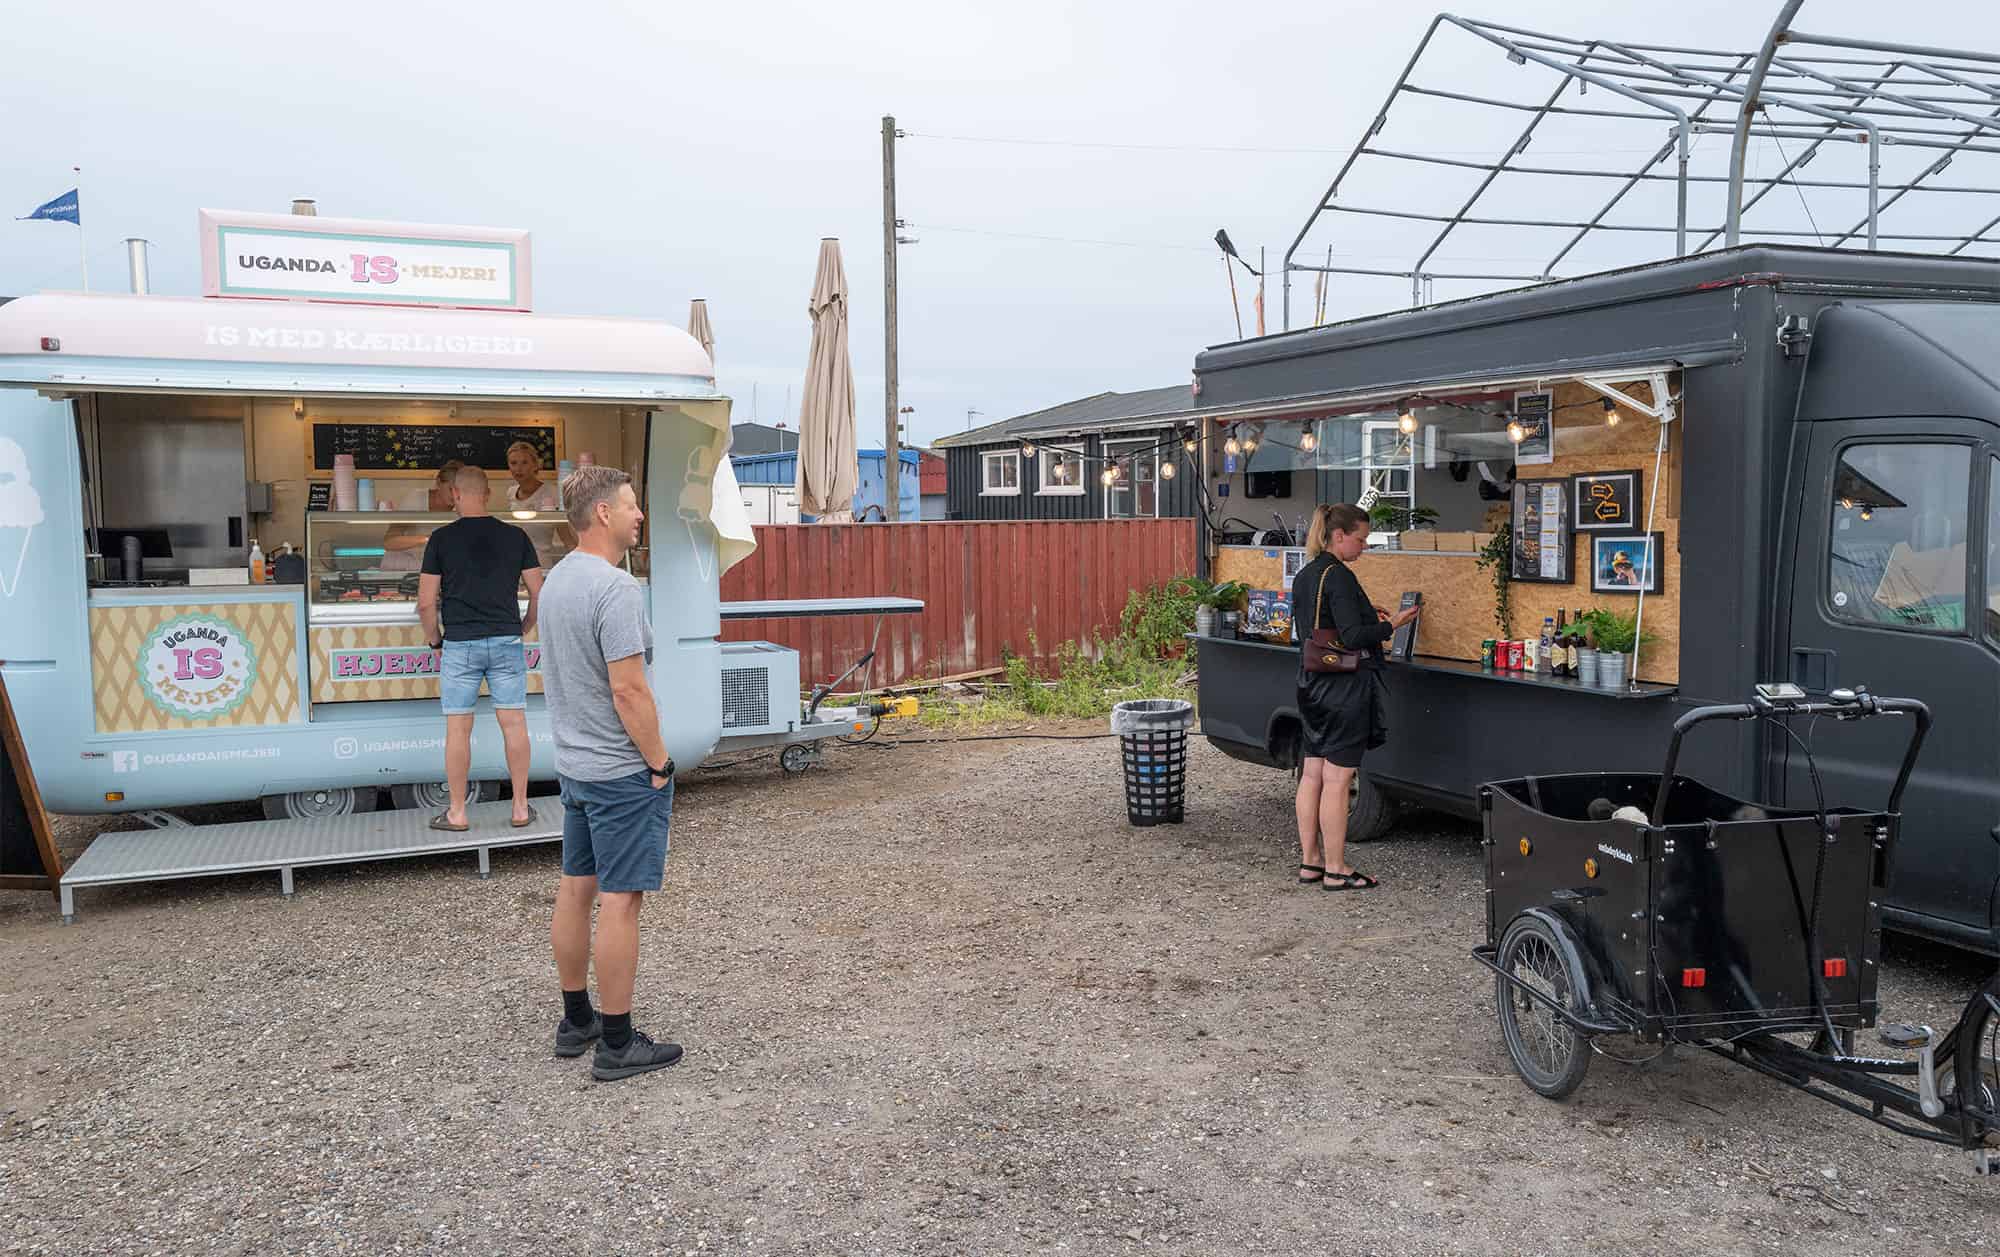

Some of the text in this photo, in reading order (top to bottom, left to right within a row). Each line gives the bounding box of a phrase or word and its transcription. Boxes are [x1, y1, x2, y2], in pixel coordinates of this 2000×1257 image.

[239, 253, 497, 285] UGANDA IS MEJERI
[204, 325, 534, 355] IS MED KÆRLIGHED
[162, 627, 229, 649] UGANDA
[173, 647, 225, 680] IS
[156, 674, 241, 705] MEJERI
